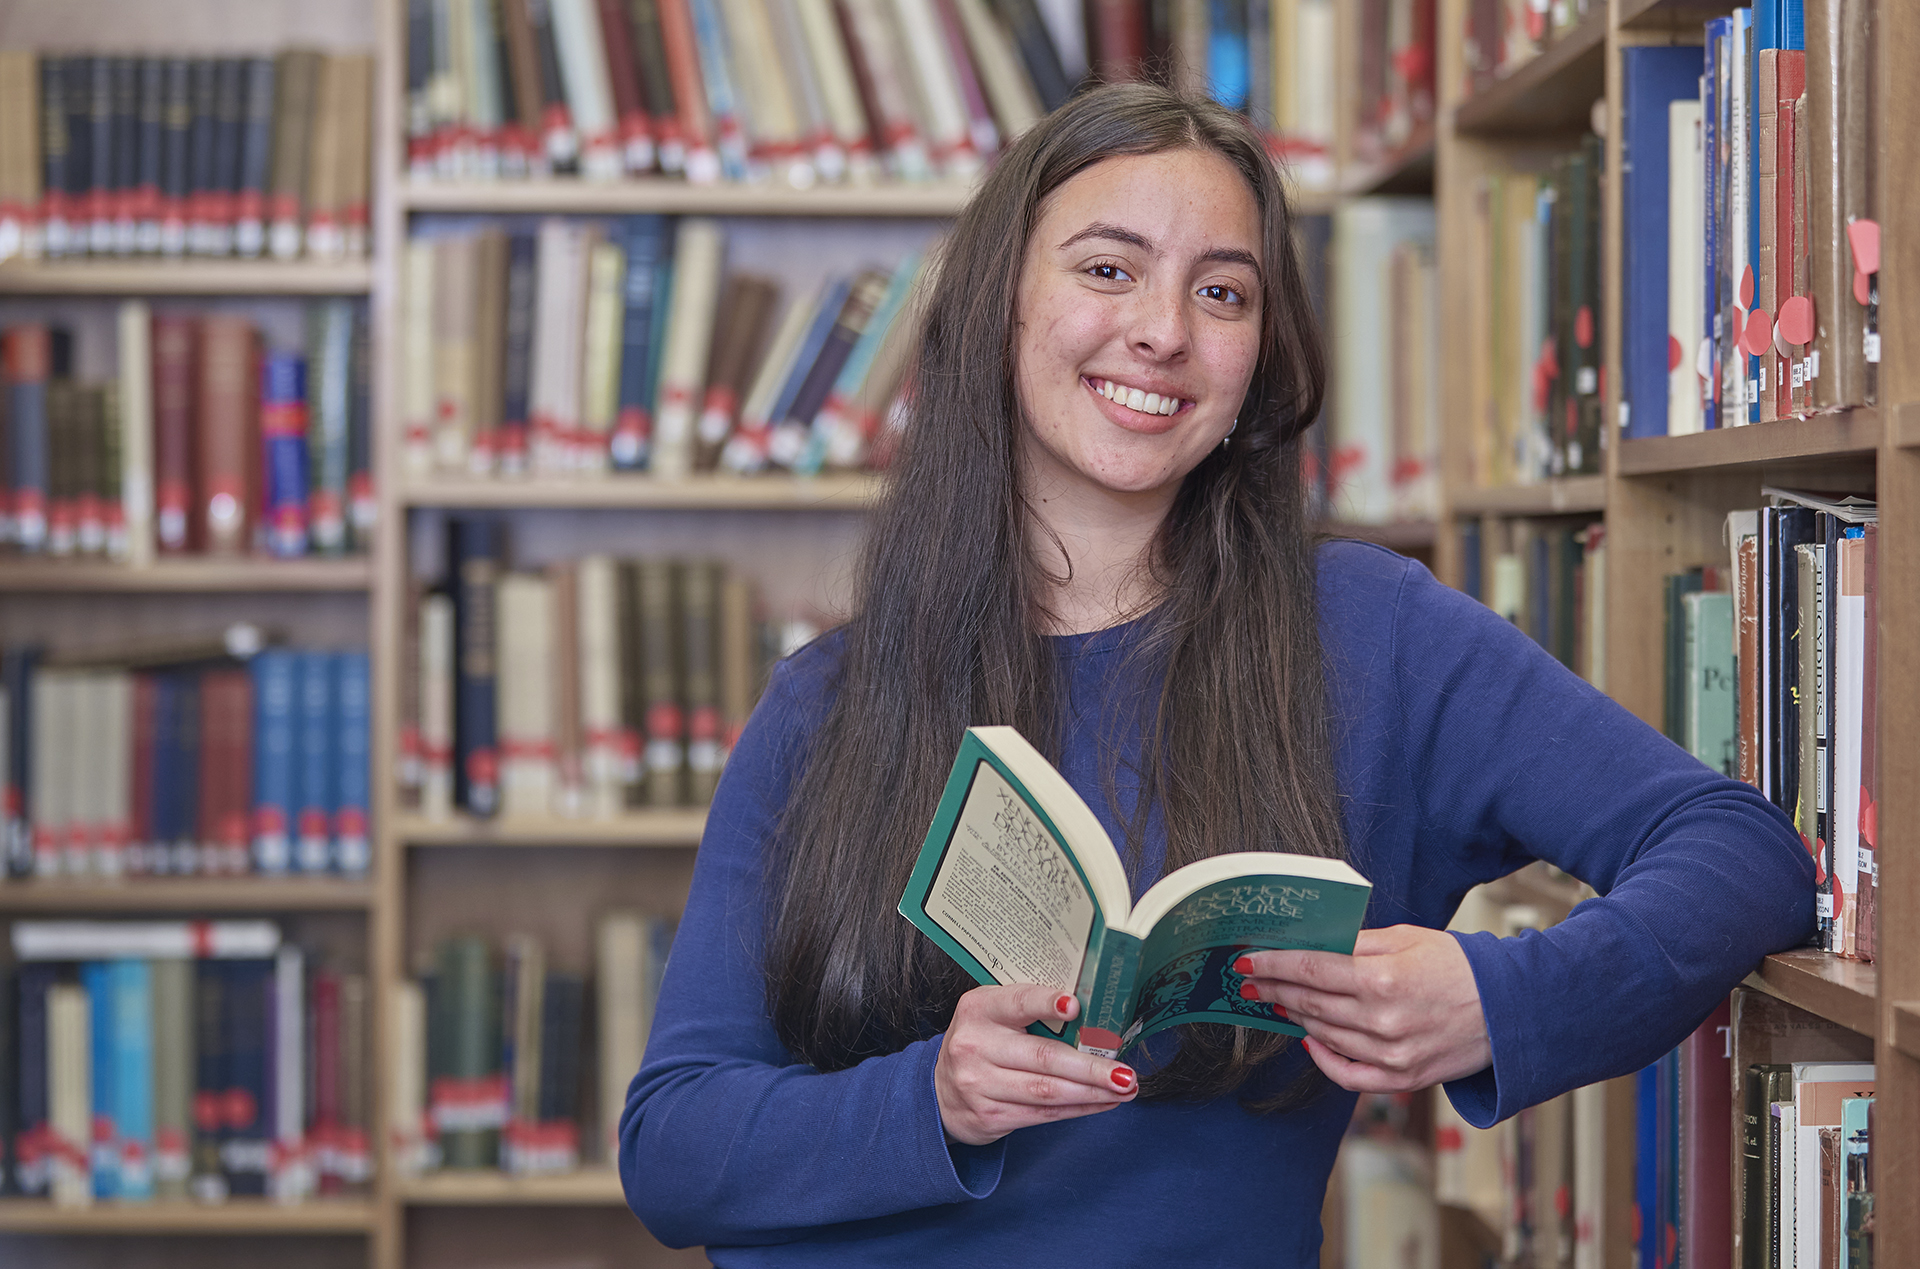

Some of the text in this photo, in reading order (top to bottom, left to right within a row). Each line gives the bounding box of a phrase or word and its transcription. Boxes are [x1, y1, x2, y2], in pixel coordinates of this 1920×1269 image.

[1732, 97, 1740, 216] HERODOTUS
[1740, 552, 1748, 607] Cornford
[993, 811, 1072, 904] DISCOURSE
